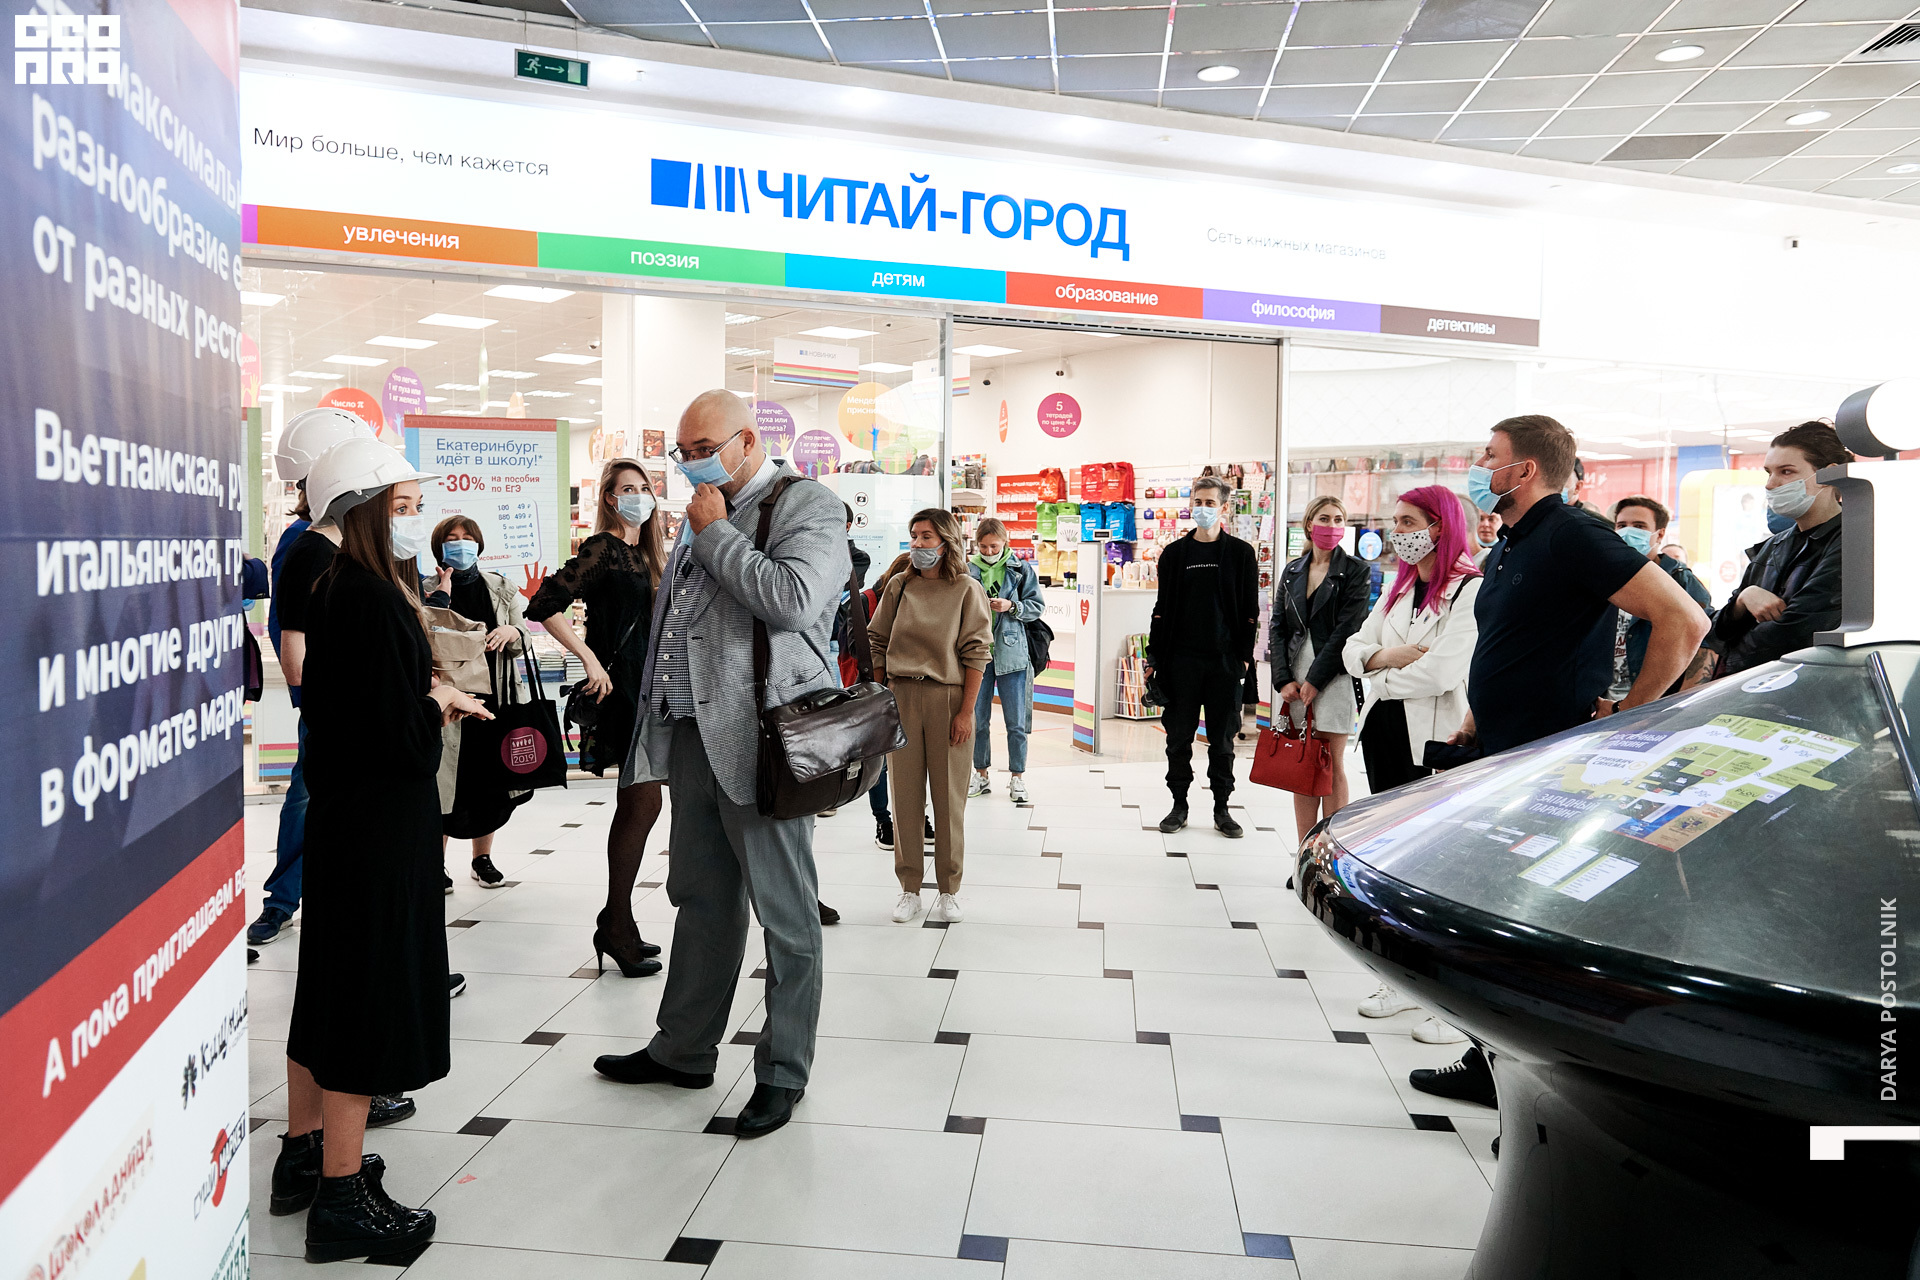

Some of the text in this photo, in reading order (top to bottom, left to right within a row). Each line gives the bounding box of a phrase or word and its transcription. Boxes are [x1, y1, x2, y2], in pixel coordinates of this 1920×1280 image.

[253, 127, 550, 177] Мир больше, чем кажется
[32, 93, 229, 282] разнообразие
[758, 169, 1130, 262] ЧИТАЙ-ГОРОД
[342, 223, 460, 250] увлечения
[1207, 227, 1386, 260] Сеть книжных магазинов
[630, 250, 700, 270] поэзия
[33, 215, 76, 283] от
[85, 241, 190, 341] разных
[871, 269, 926, 289] детям
[1054, 284, 1159, 306] образование
[1251, 300, 1336, 322] философия
[1427, 316, 1496, 336] детективы
[331, 399, 356, 408] Число
[1056, 401, 1063, 411] 5
[757, 417, 773, 425] пуха
[437, 438, 538, 455] Екатеринбург
[35, 408, 224, 508] Вьетнамская,
[436, 452, 470, 466] идёт
[475, 456, 483, 464] в
[438, 473, 485, 492] -30%
[505, 474, 540, 483] пособия
[37, 539, 222, 597] итальянская,
[38, 654, 66, 712] и
[76, 627, 182, 700] многие
[41, 768, 65, 828] в
[73, 708, 197, 822] формате
[514, 754, 534, 764] 2019
[1529, 803, 1582, 819] ПАРКИНГ
[42, 1037, 66, 1098] А
[72, 983, 129, 1067] пока
[133, 877, 234, 1002] приглашаем
